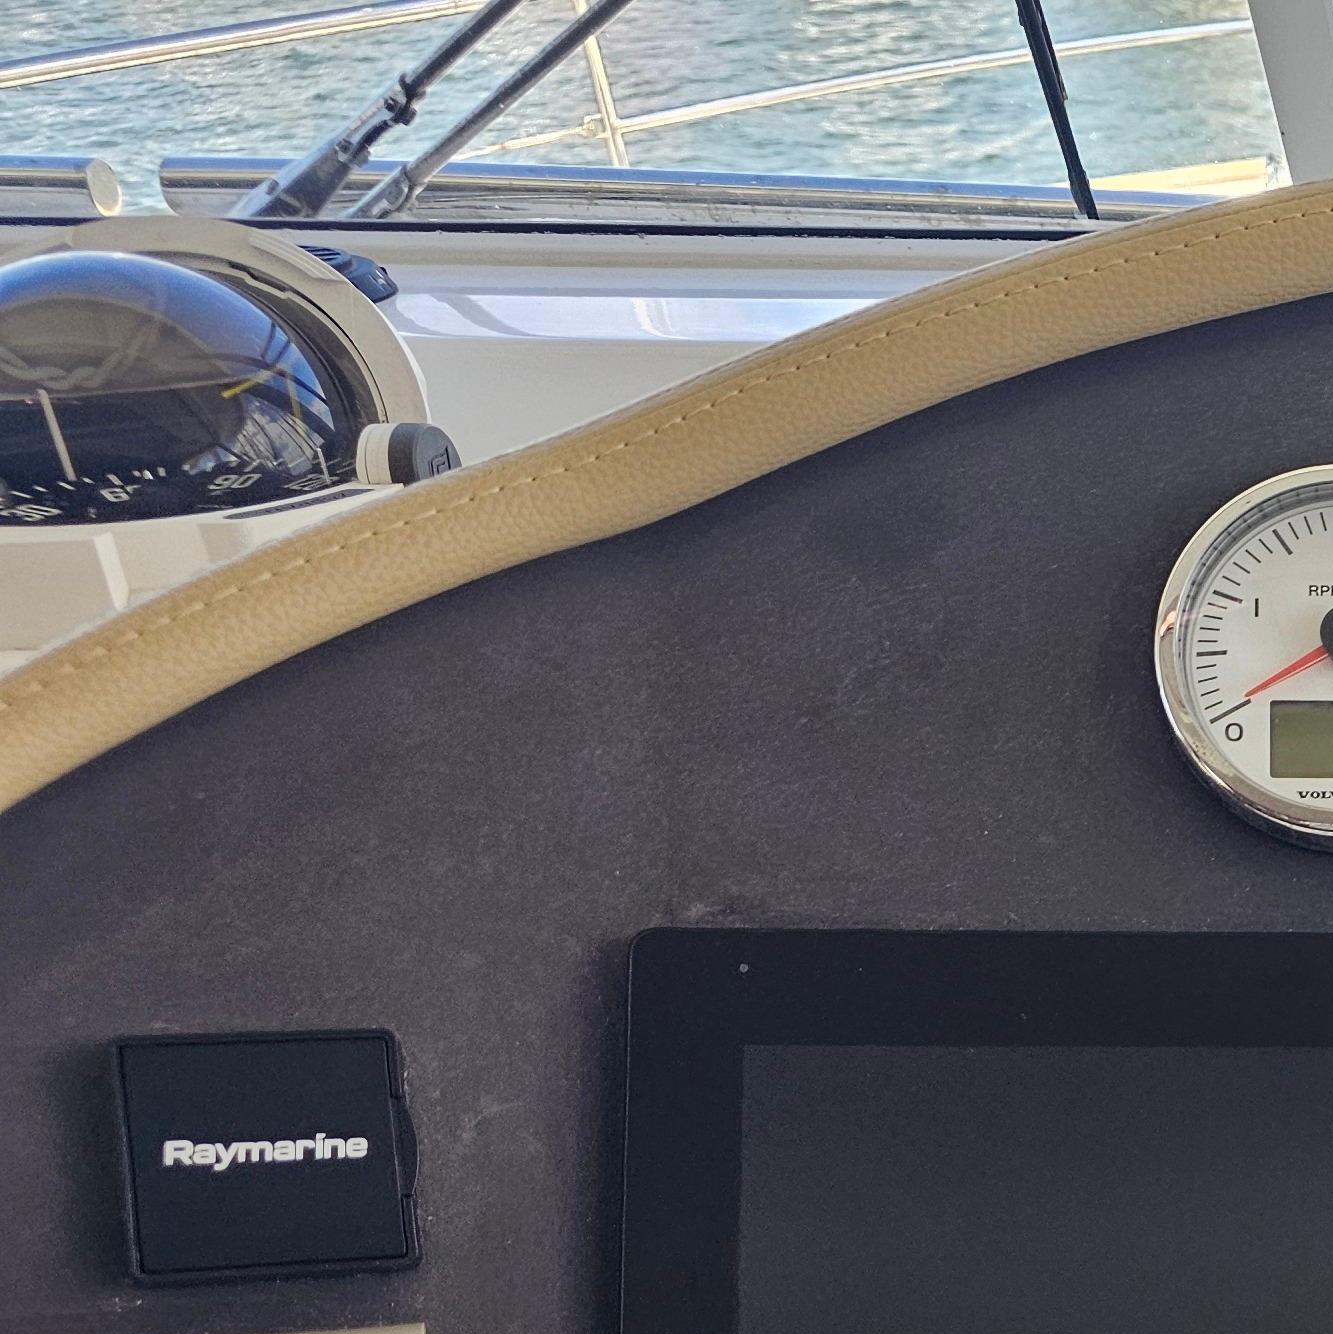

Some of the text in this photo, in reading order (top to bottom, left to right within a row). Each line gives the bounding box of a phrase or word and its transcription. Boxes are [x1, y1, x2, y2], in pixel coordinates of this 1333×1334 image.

[207, 473, 263, 490] 90
[1224, 722, 1244, 742] 0
[163, 1132, 369, 1172] Raymarine
